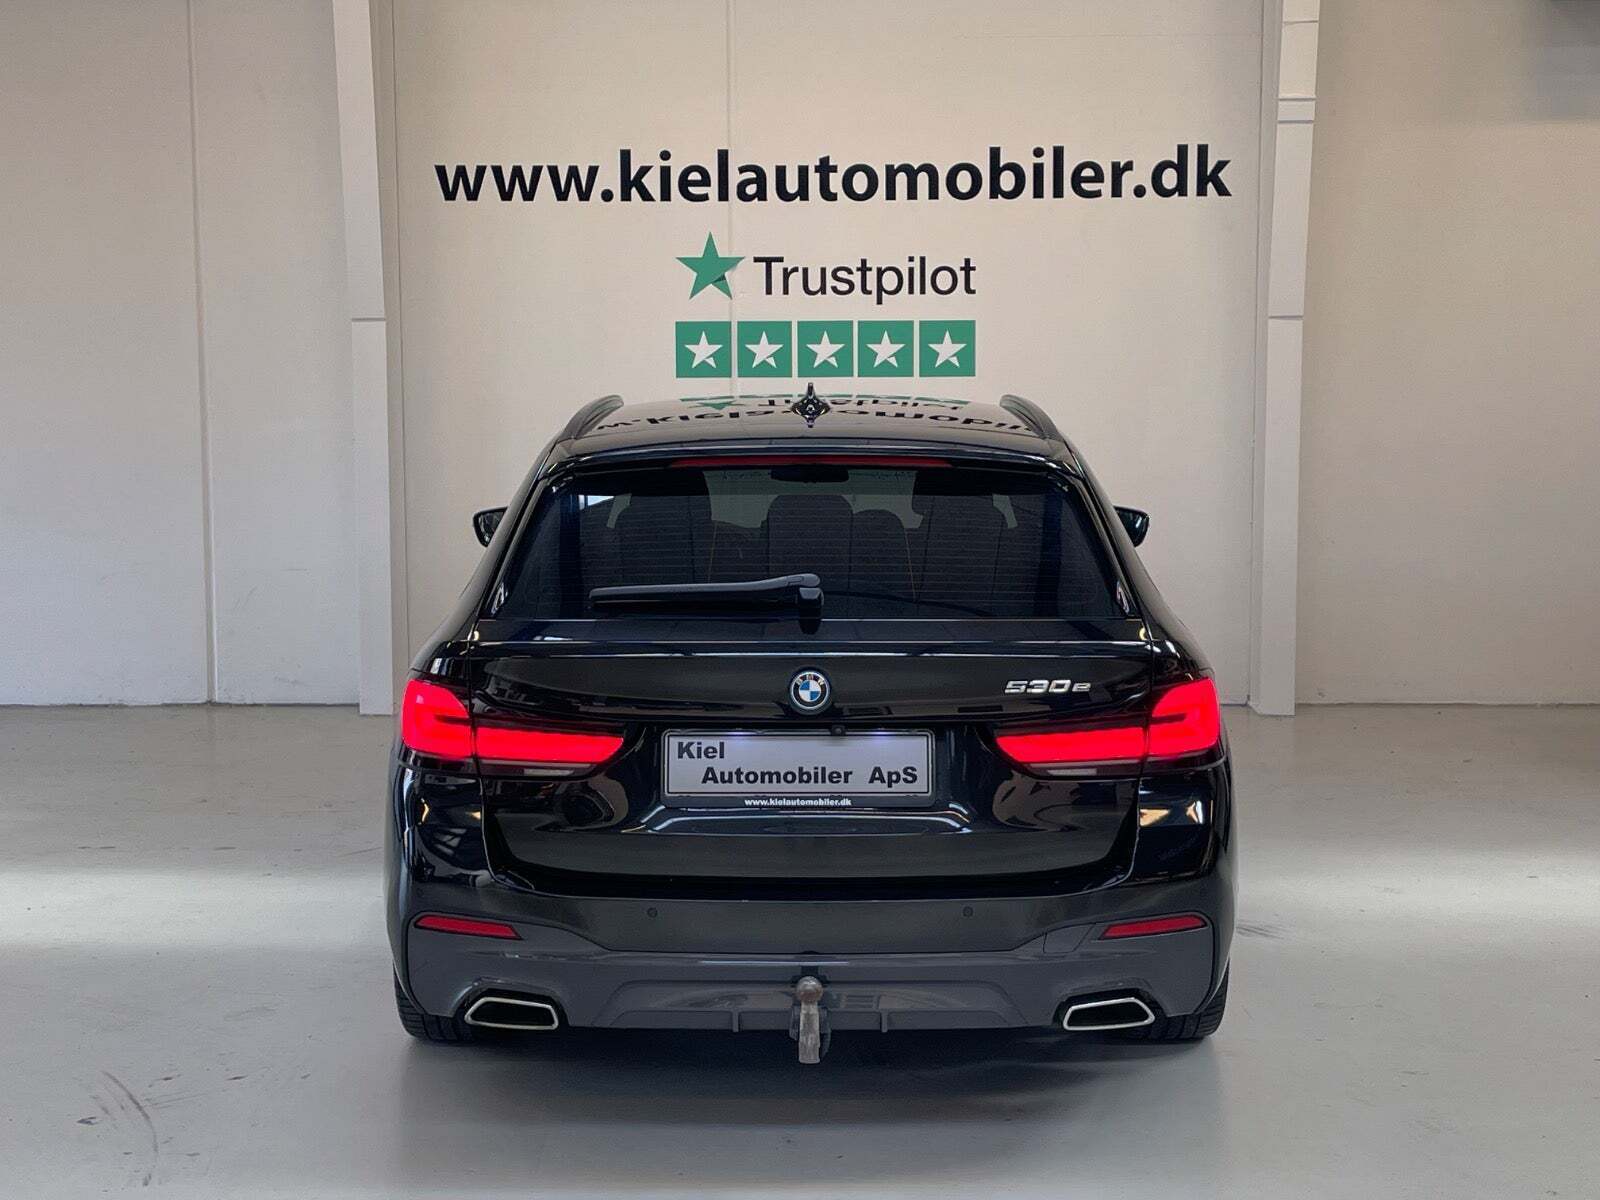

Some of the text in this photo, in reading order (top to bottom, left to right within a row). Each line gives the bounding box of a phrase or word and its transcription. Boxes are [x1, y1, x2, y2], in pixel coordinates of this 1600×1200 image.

[435, 144, 1232, 202] www.kielautomobiler.dk
[754, 256, 976, 305] Trustpilot
[1005, 680, 1090, 693] 530e
[678, 742, 724, 759] Kiel
[701, 767, 917, 788] Automobiler ApS
